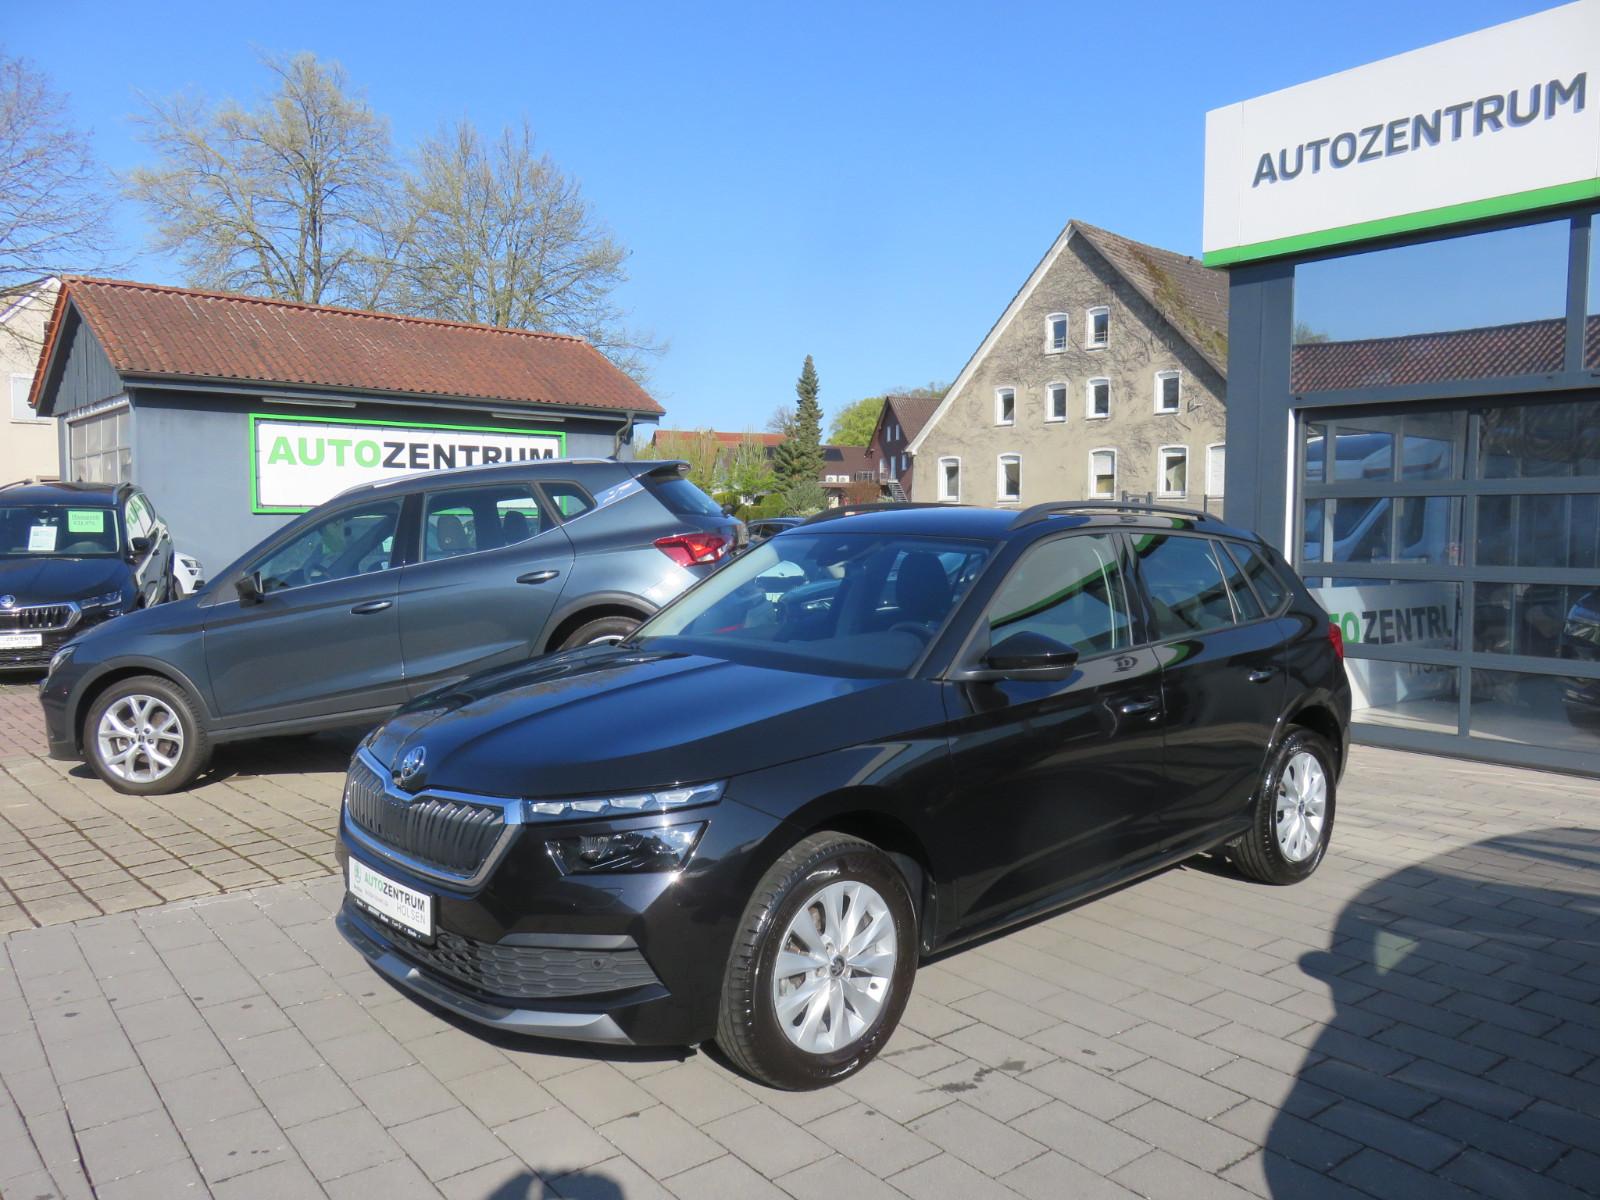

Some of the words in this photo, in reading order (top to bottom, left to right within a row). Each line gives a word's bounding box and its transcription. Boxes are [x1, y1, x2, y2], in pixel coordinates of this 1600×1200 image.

[1252, 72, 1587, 188] AUTOZENTRUM
[364, 872, 425, 912] AUTOZENTRUM
[397, 904, 426, 925] HOLSEN
